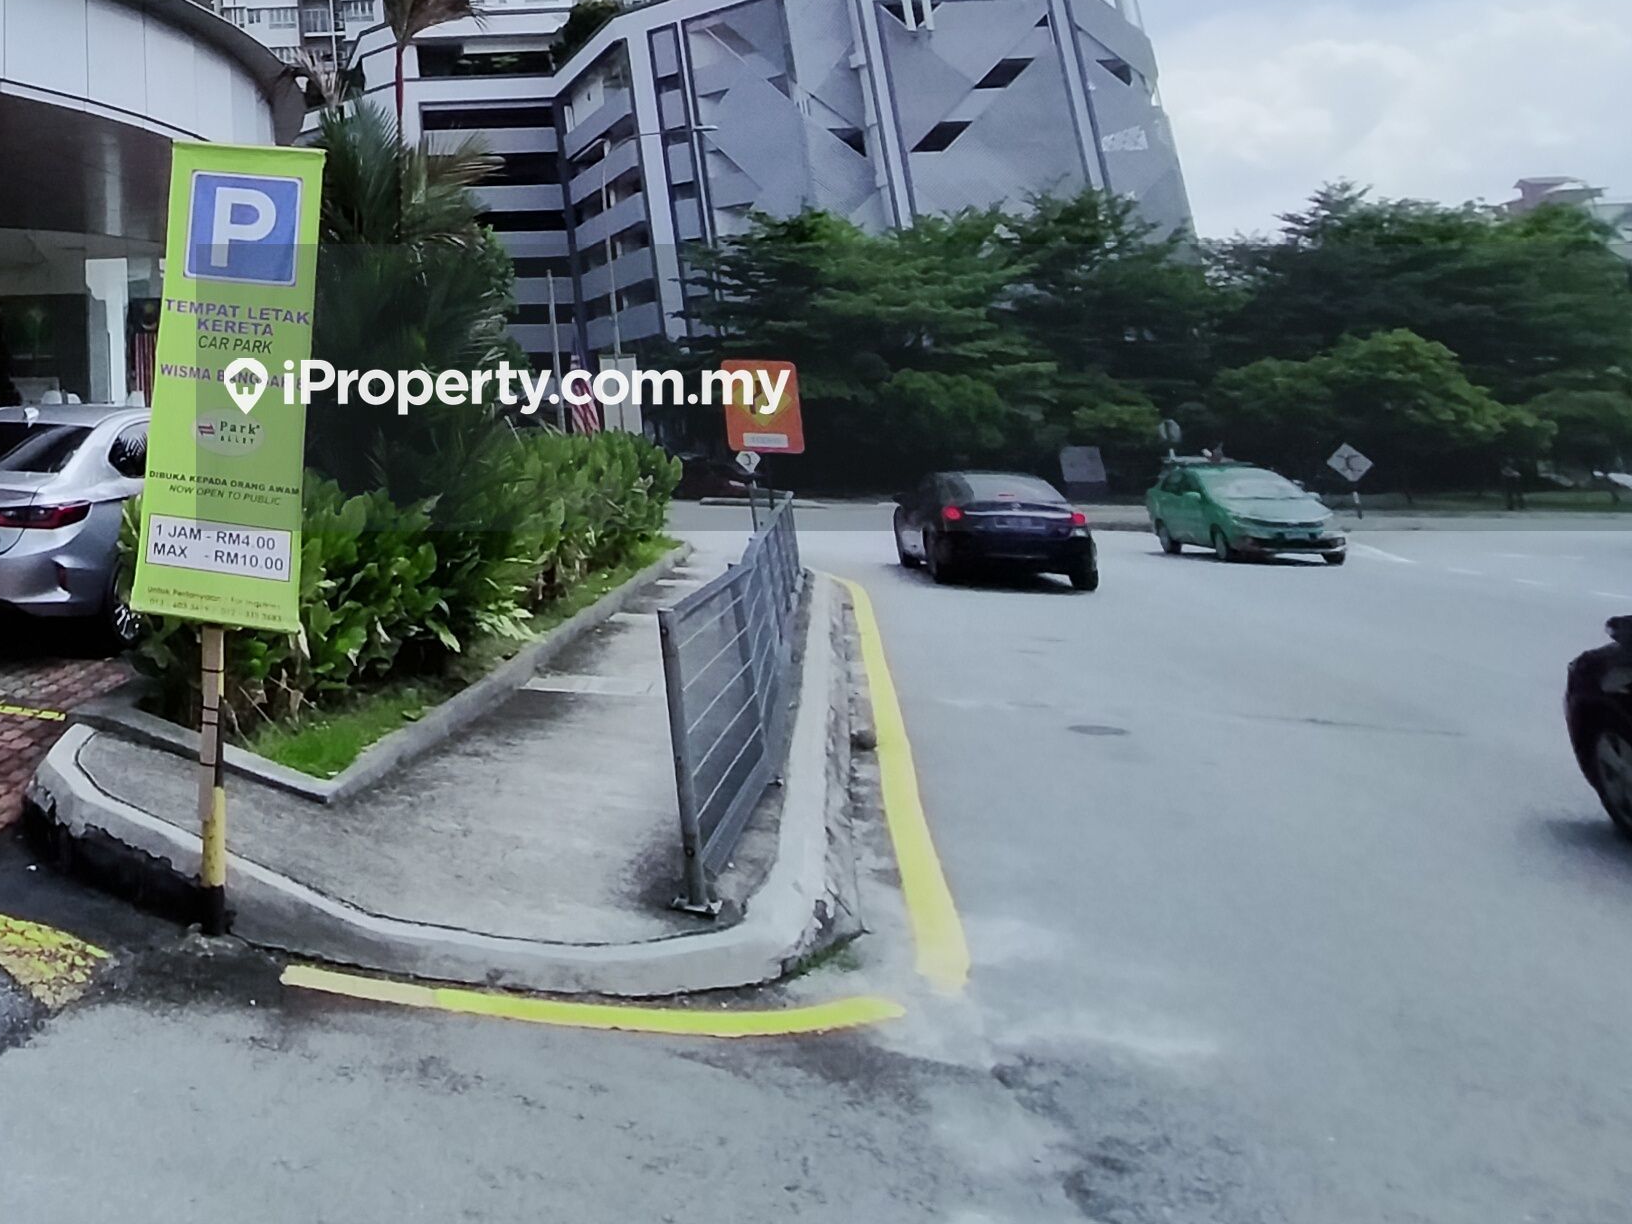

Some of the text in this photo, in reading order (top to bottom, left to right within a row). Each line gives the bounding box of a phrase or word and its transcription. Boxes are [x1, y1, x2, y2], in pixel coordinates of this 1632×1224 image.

[210, 186, 277, 268] P
[165, 298, 310, 325] TEMPAT LETAK
[197, 318, 274, 336] KERETA
[198, 335, 274, 354] CAR PARK
[160, 363, 211, 381] WISMA
[220, 420, 256, 435] Park
[149, 470, 300, 495] DIBUKA KEPADA ORANG AWAM
[168, 484, 281, 506] NOW OPEN TO PUBLIC
[156, 524, 162, 537] 1
[168, 525, 202, 542] JAM
[216, 531, 276, 550] RM4.00
[153, 542, 188, 559] MAX
[214, 550, 284, 572] RM10.00
